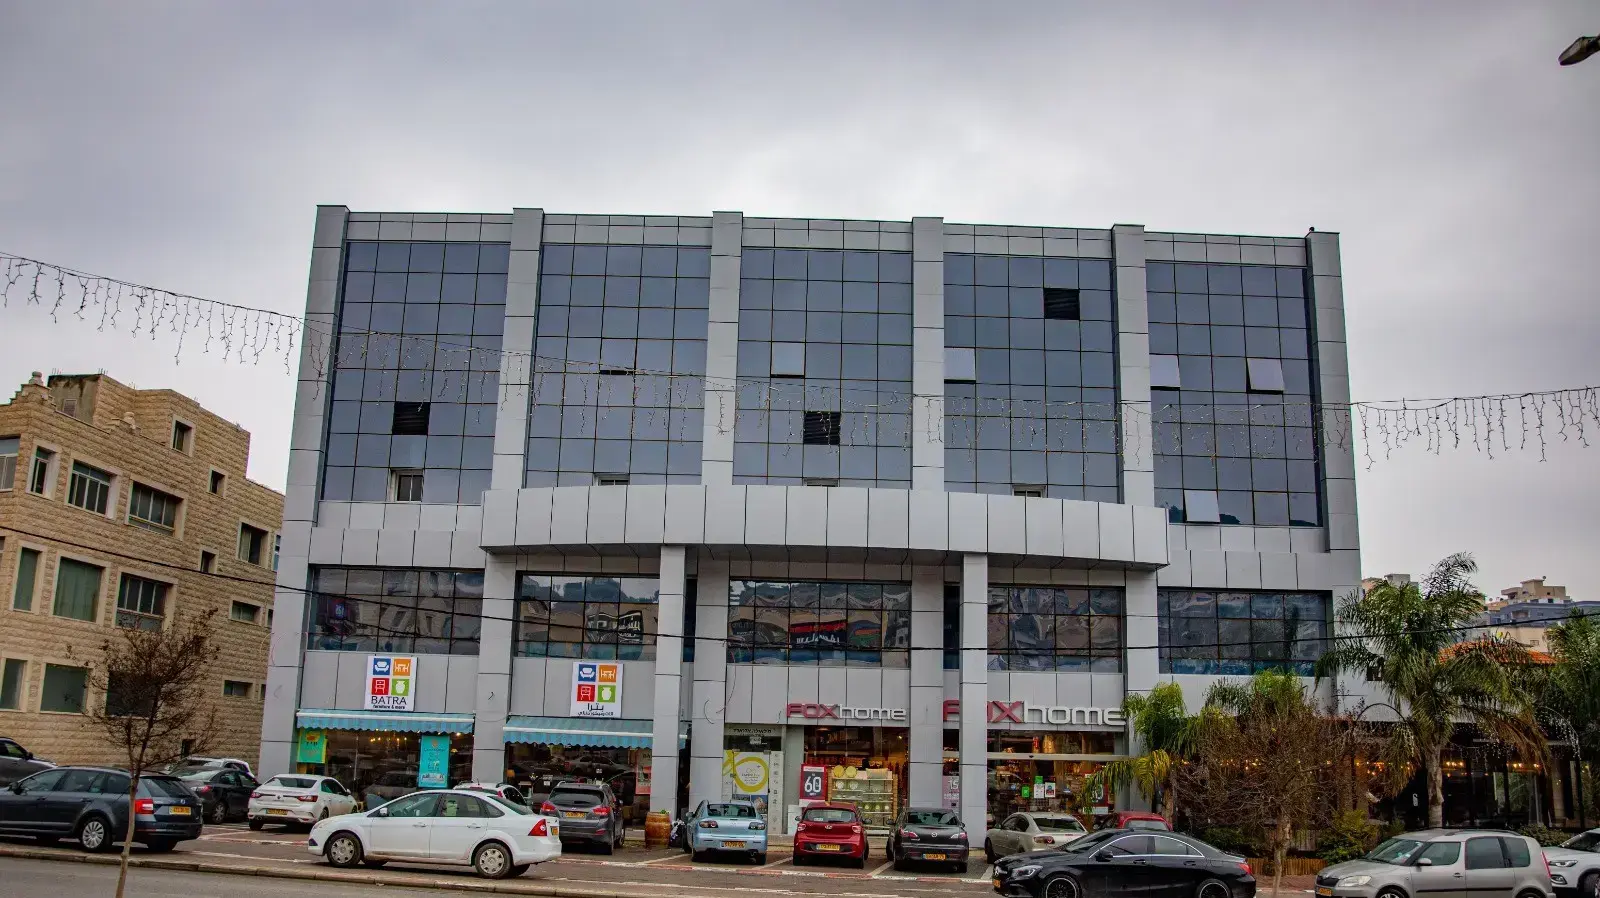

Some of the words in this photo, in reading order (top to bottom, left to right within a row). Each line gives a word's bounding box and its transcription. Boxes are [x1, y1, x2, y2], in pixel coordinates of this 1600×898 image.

[371, 696, 407, 705] BATRA
[587, 702, 604, 712] بترا
[804, 776, 822, 793] 60
